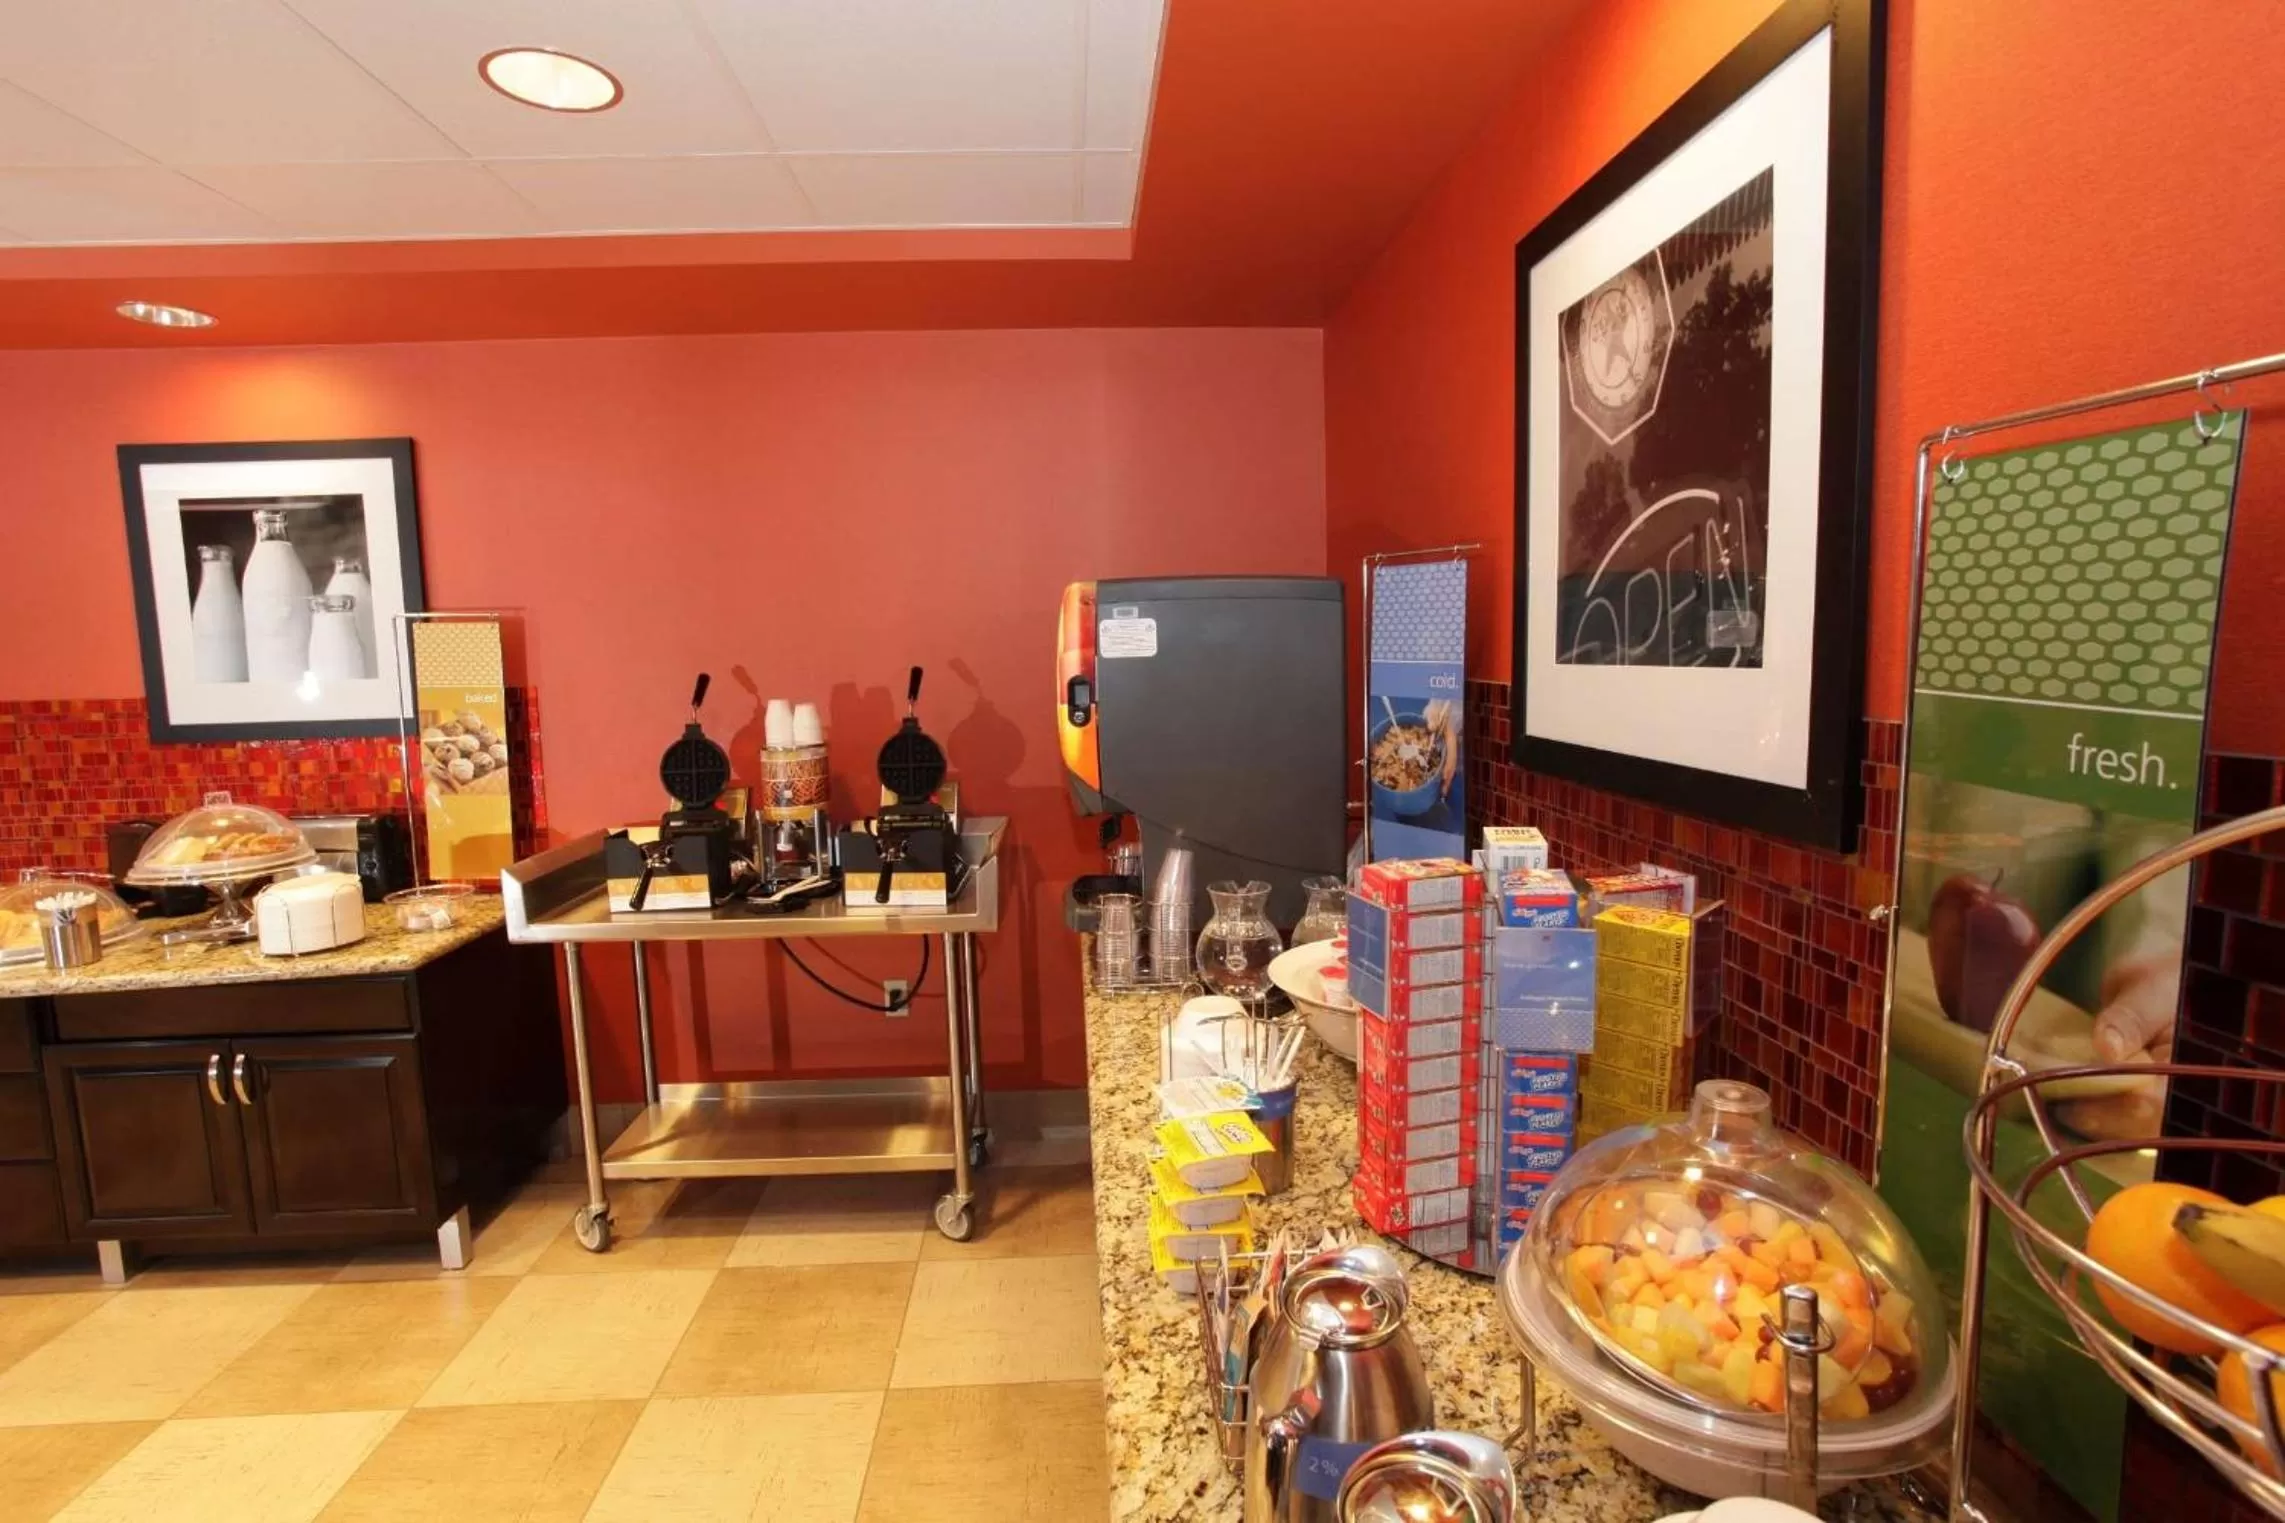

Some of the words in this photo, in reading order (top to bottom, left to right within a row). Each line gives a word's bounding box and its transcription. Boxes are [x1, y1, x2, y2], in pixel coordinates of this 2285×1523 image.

[1430, 671, 1459, 689] cold.
[2067, 732, 2178, 790] fresh.
[1309, 1455, 1340, 1476] 2%
